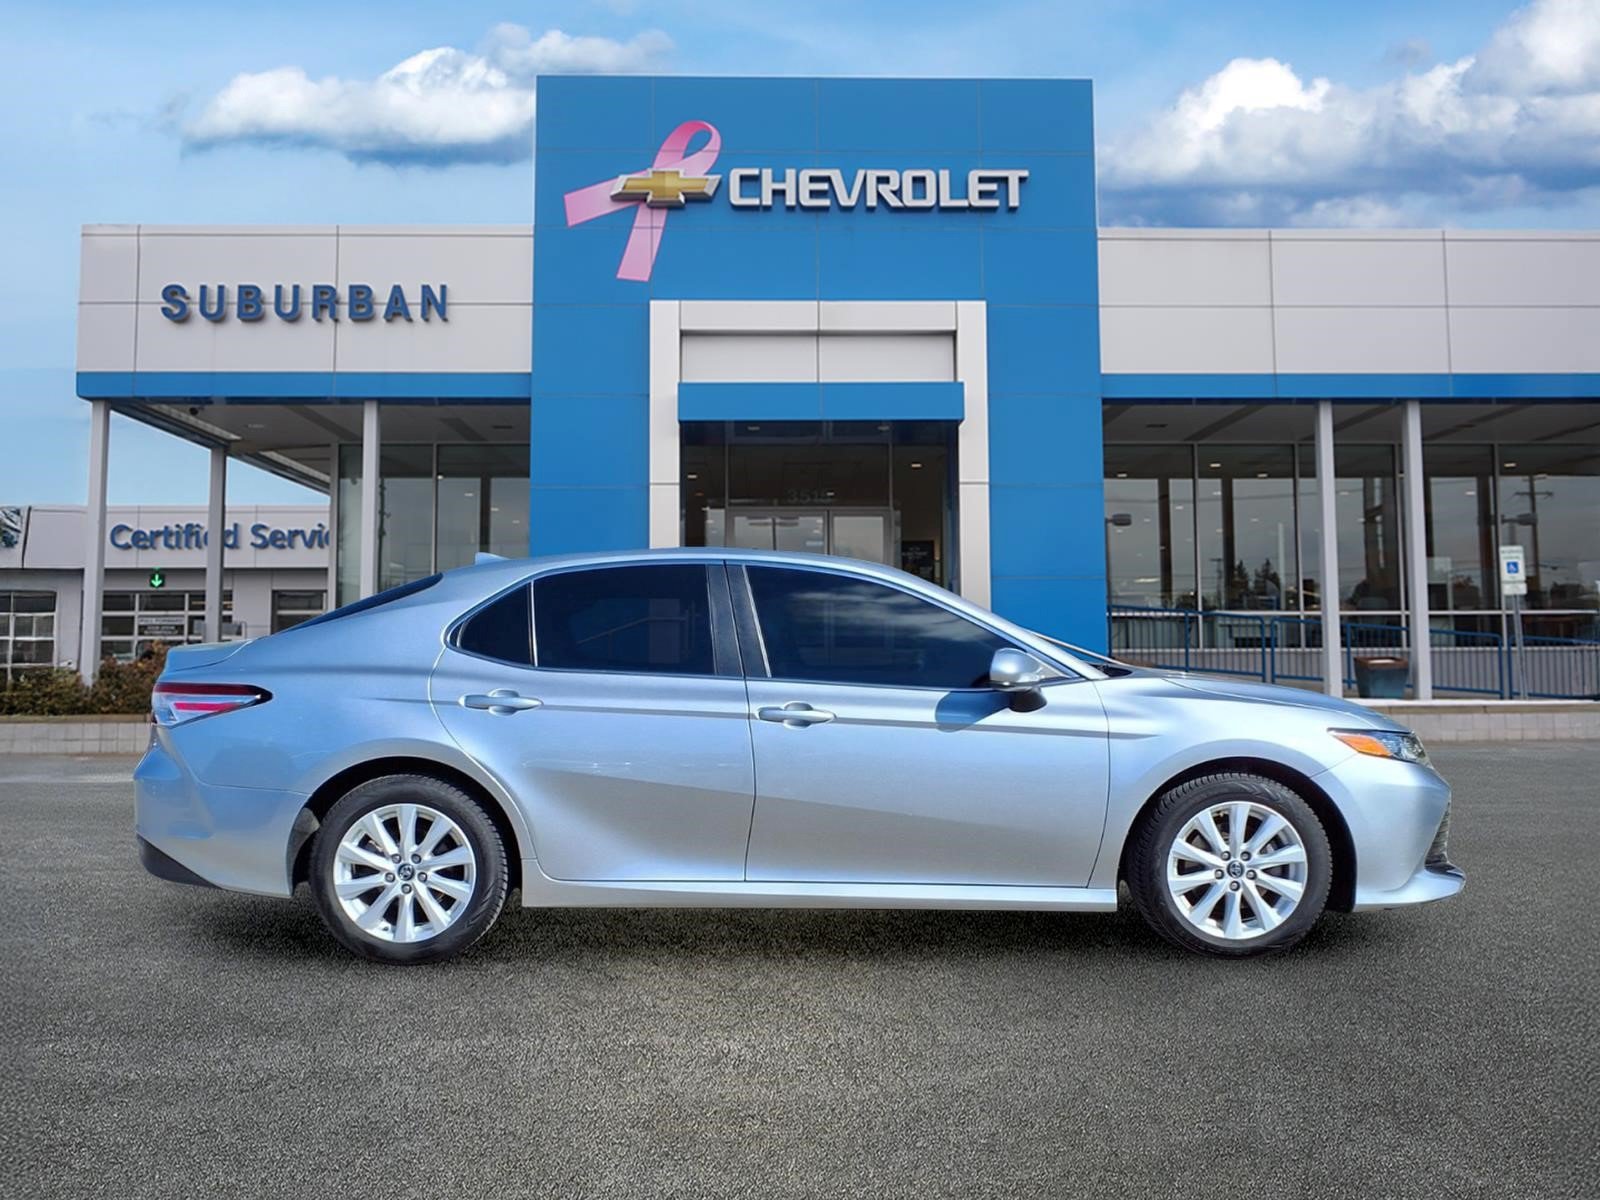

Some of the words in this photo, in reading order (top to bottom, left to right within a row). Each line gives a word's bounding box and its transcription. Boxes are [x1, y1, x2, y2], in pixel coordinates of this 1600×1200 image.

[729, 167, 1029, 210] CHEVROLET
[160, 284, 449, 323] SUBURBAN
[109, 522, 240, 550] Certifid
